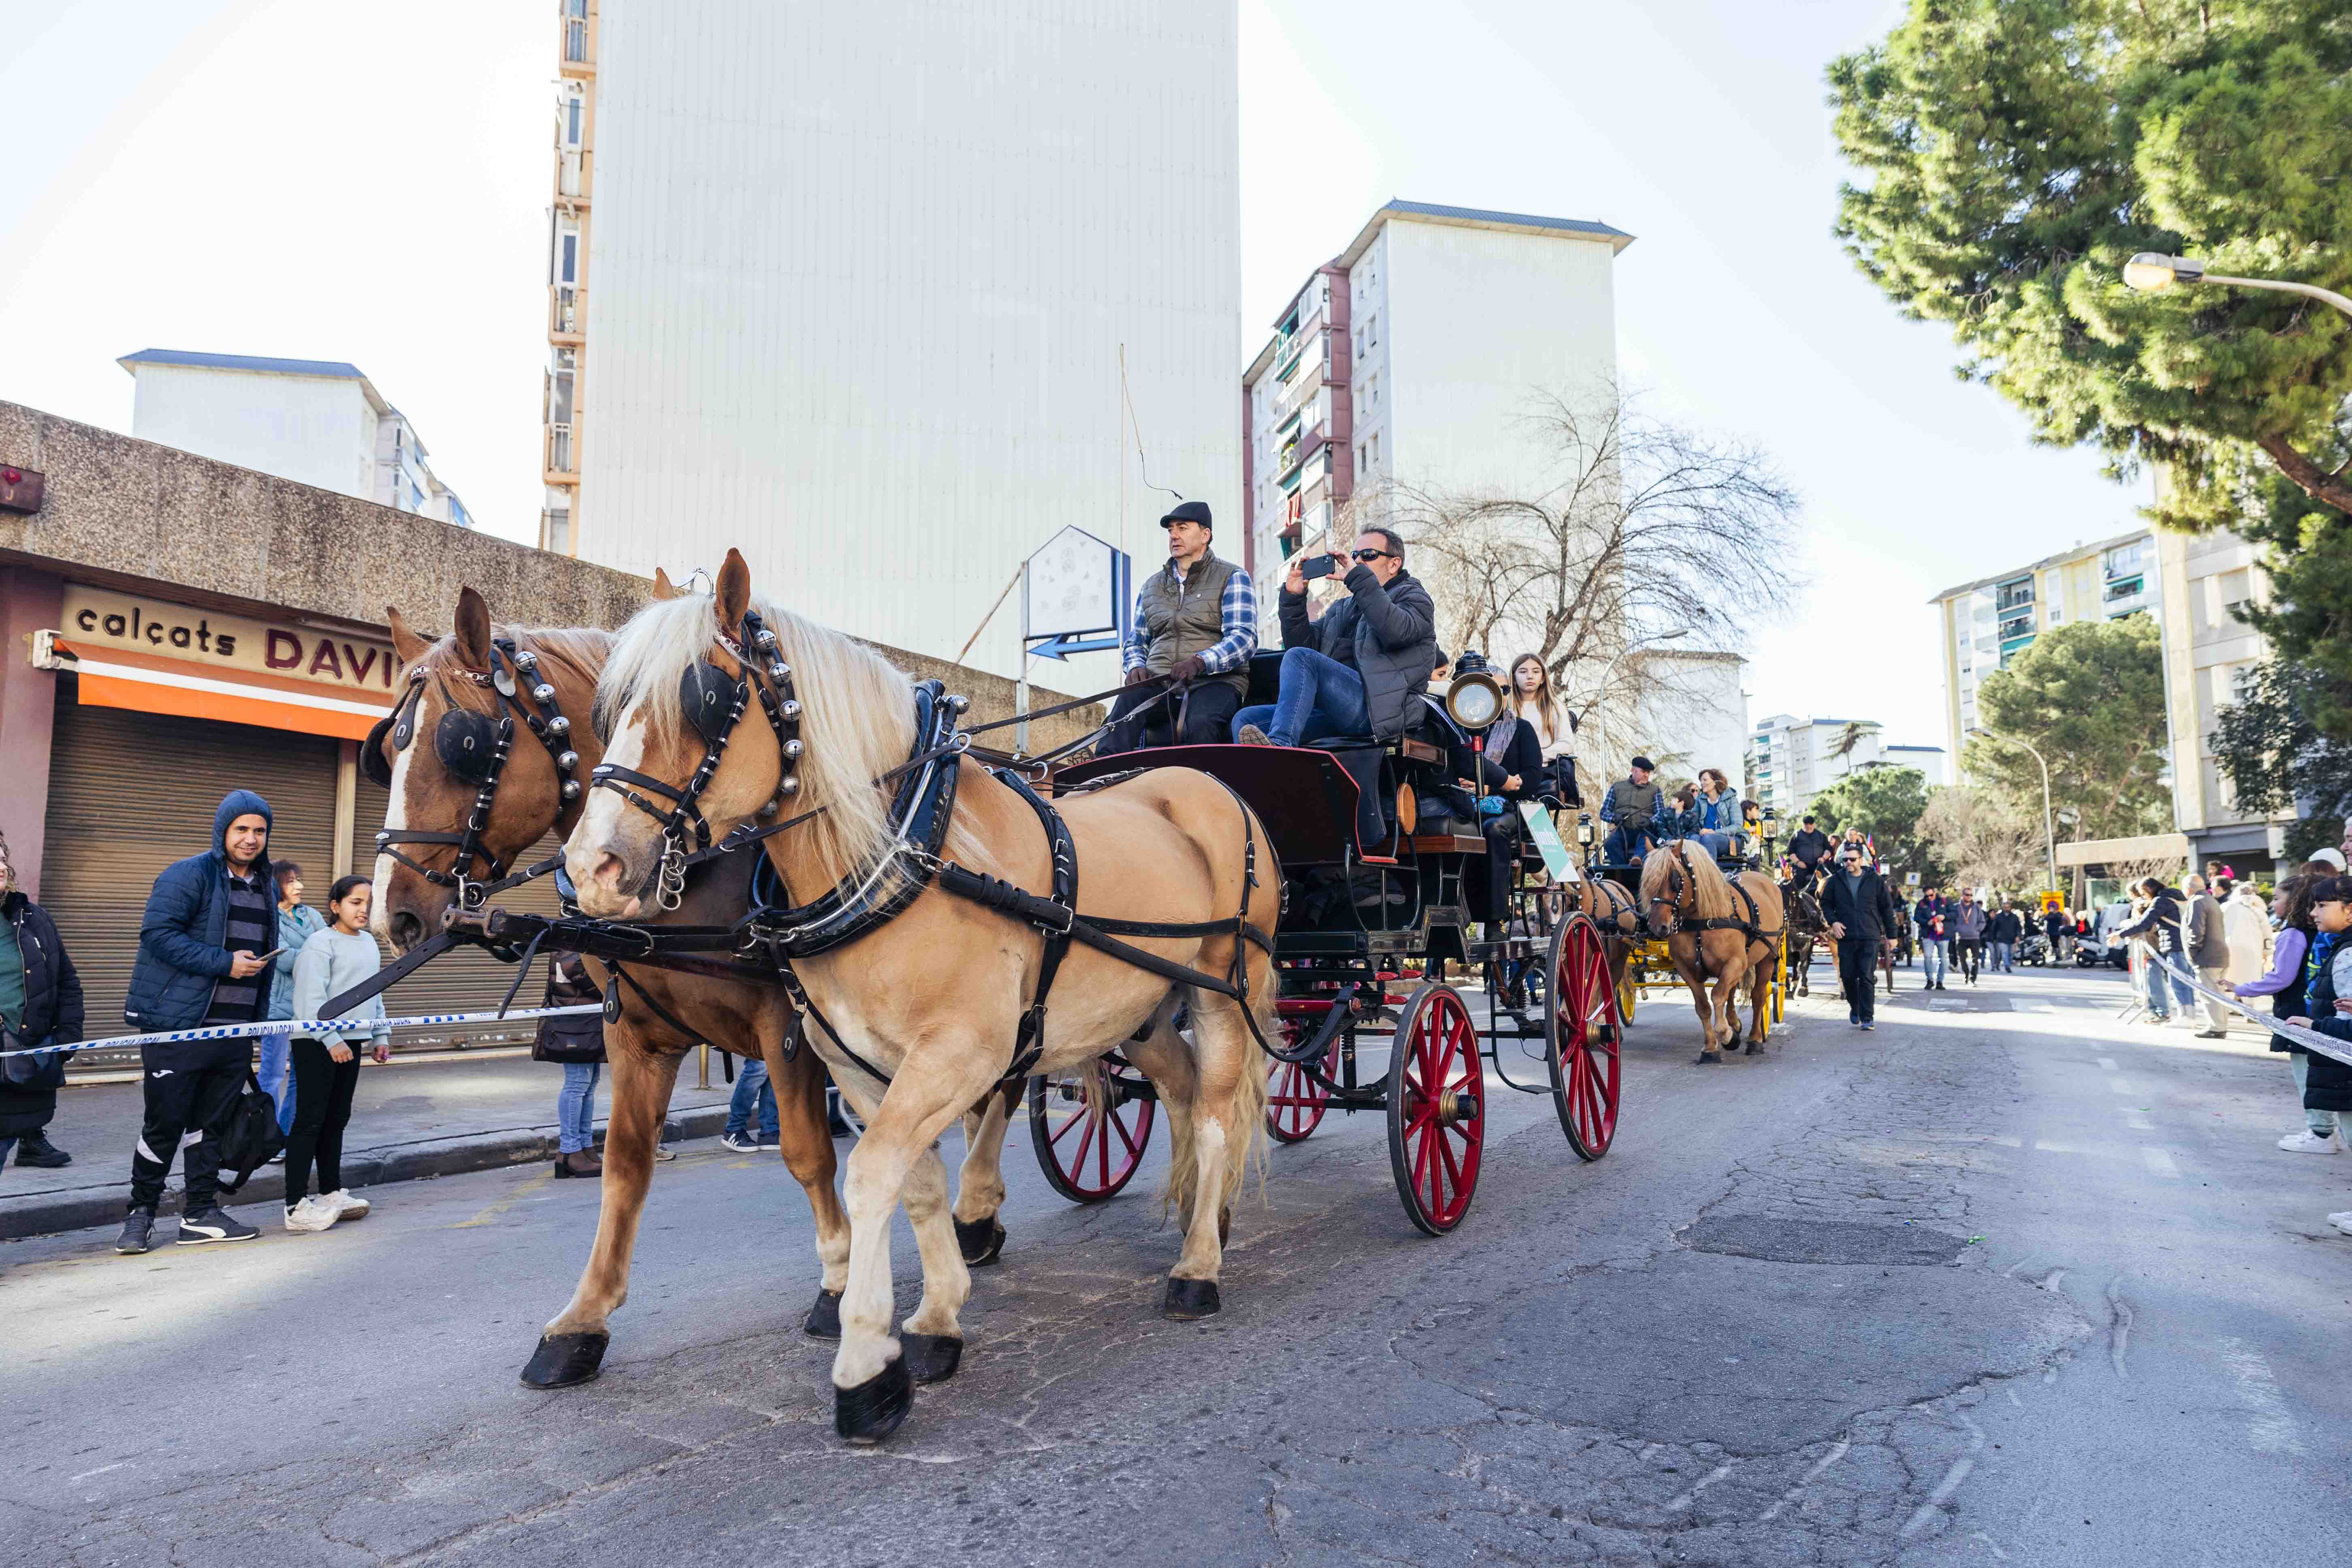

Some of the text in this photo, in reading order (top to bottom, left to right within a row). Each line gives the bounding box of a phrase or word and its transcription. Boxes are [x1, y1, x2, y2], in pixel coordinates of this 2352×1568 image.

[76, 608, 403, 688] calçats DAVI
[247, 1024, 294, 1036] POLICIA LOCAL
